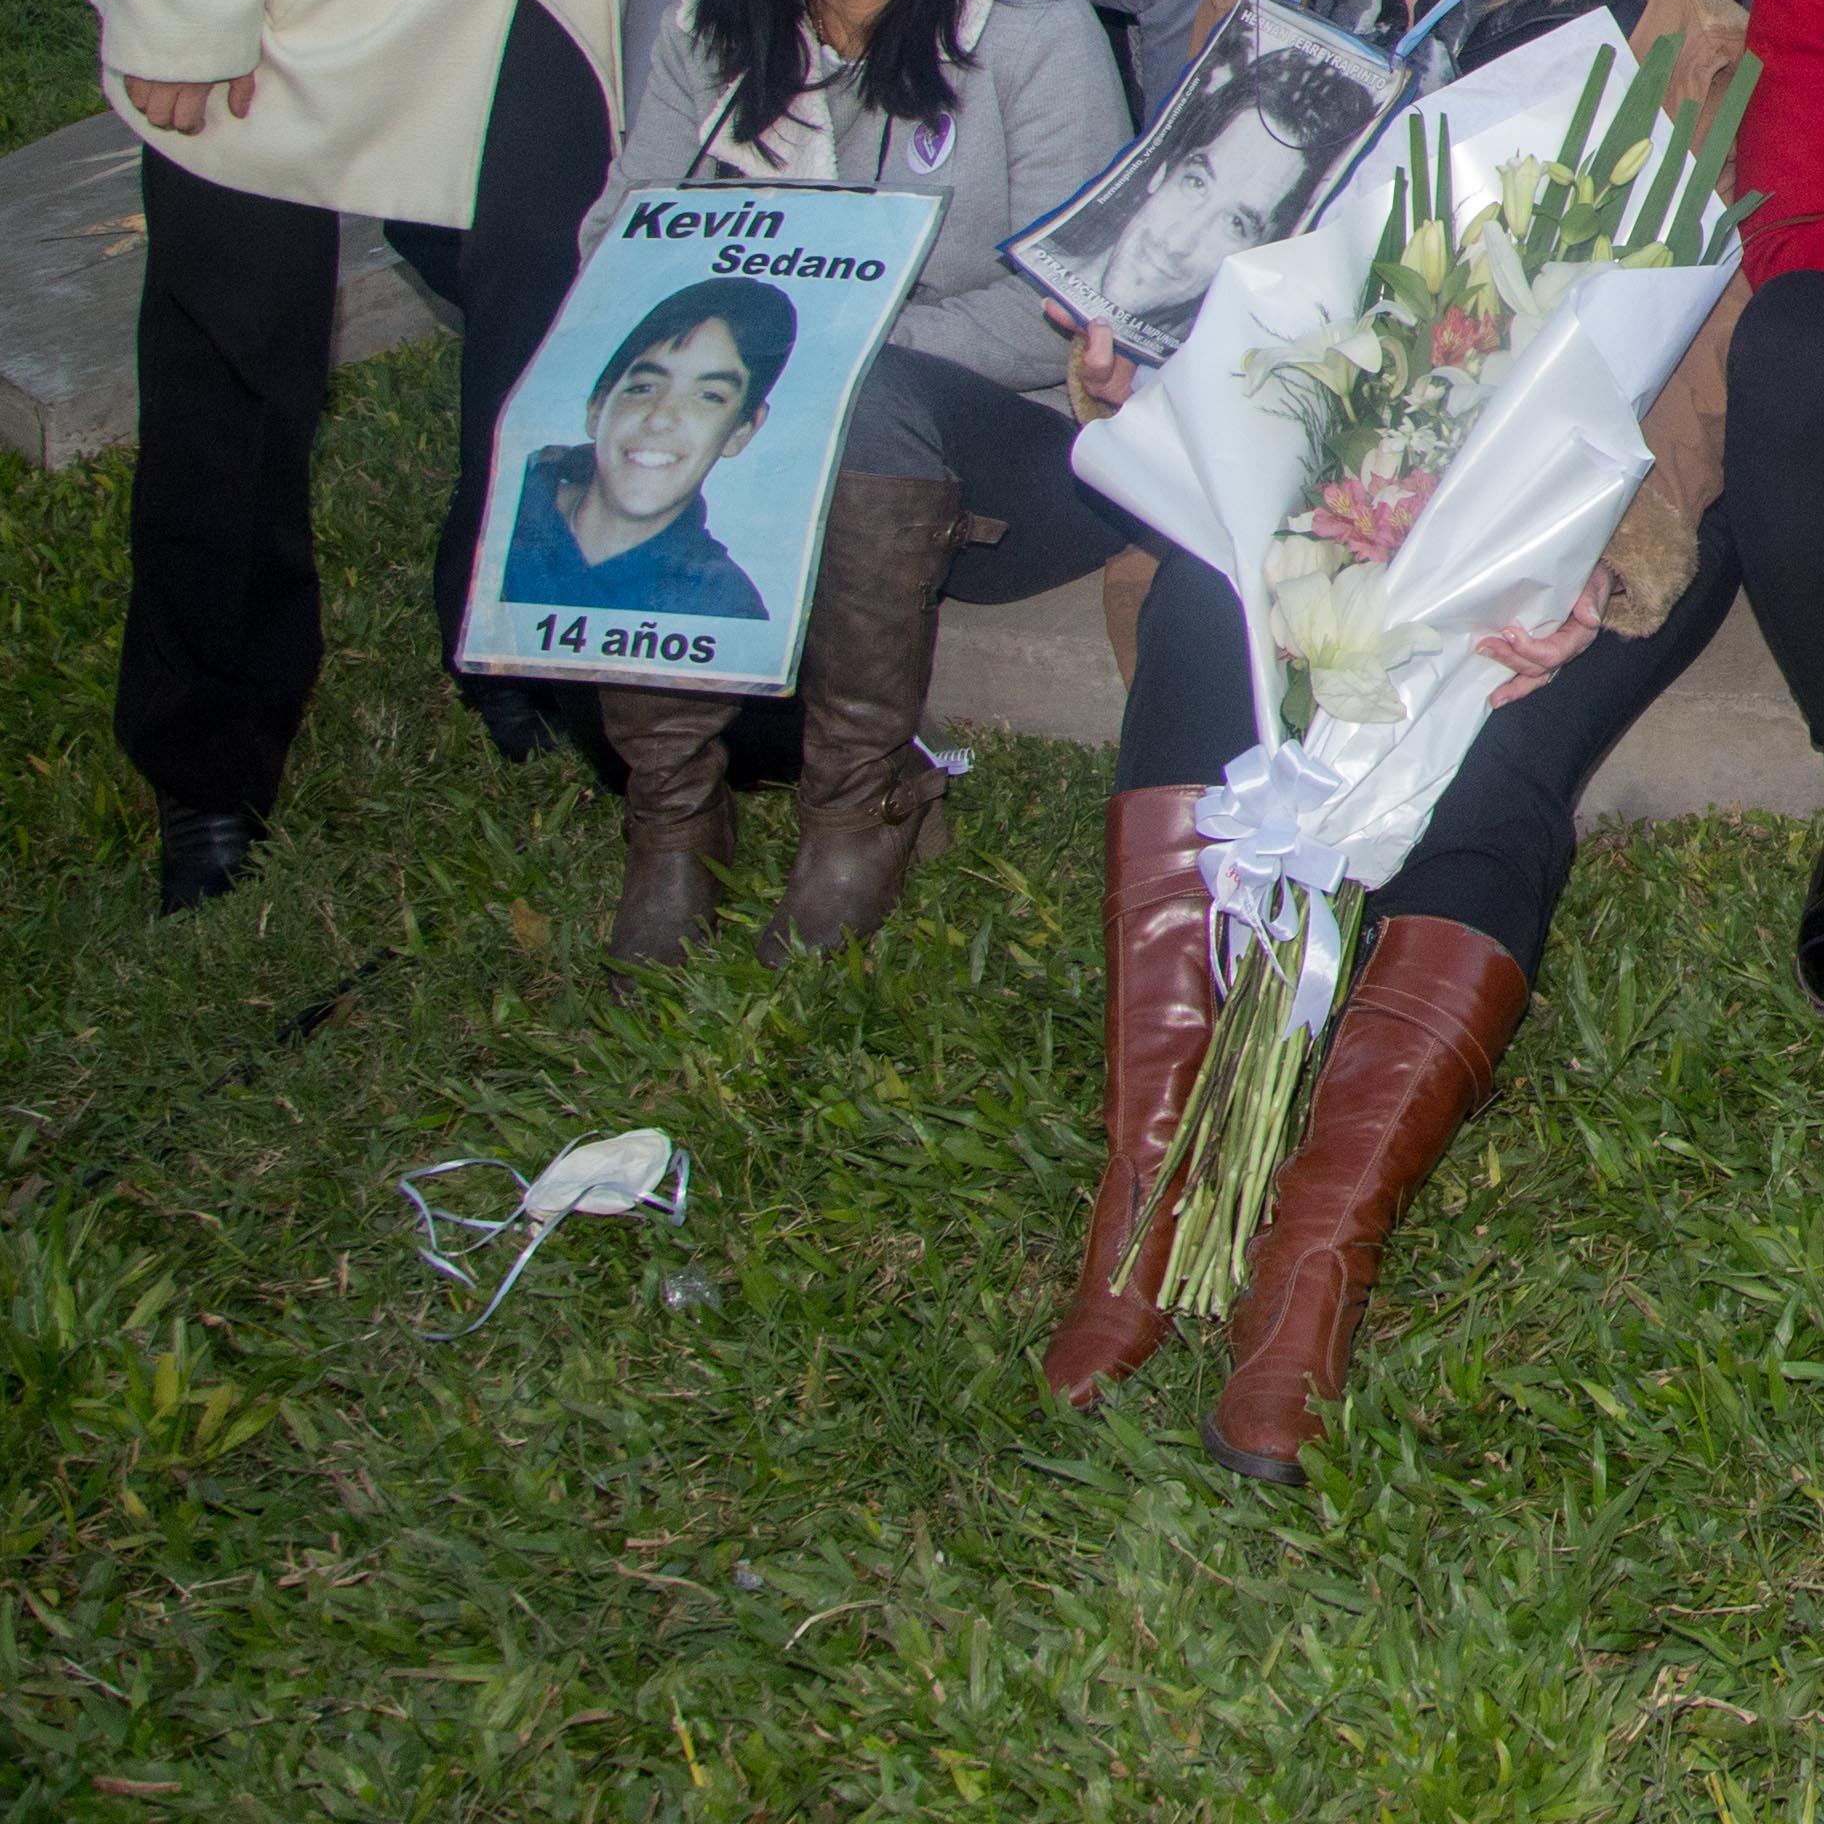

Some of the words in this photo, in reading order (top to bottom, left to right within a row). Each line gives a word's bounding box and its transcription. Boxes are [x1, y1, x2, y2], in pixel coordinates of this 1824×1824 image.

[622, 201, 785, 239] Kevin
[711, 244, 886, 281] Sedano
[1035, 249, 1070, 280] OTRA
[536, 613, 588, 653] 14
[601, 621, 717, 663] años
